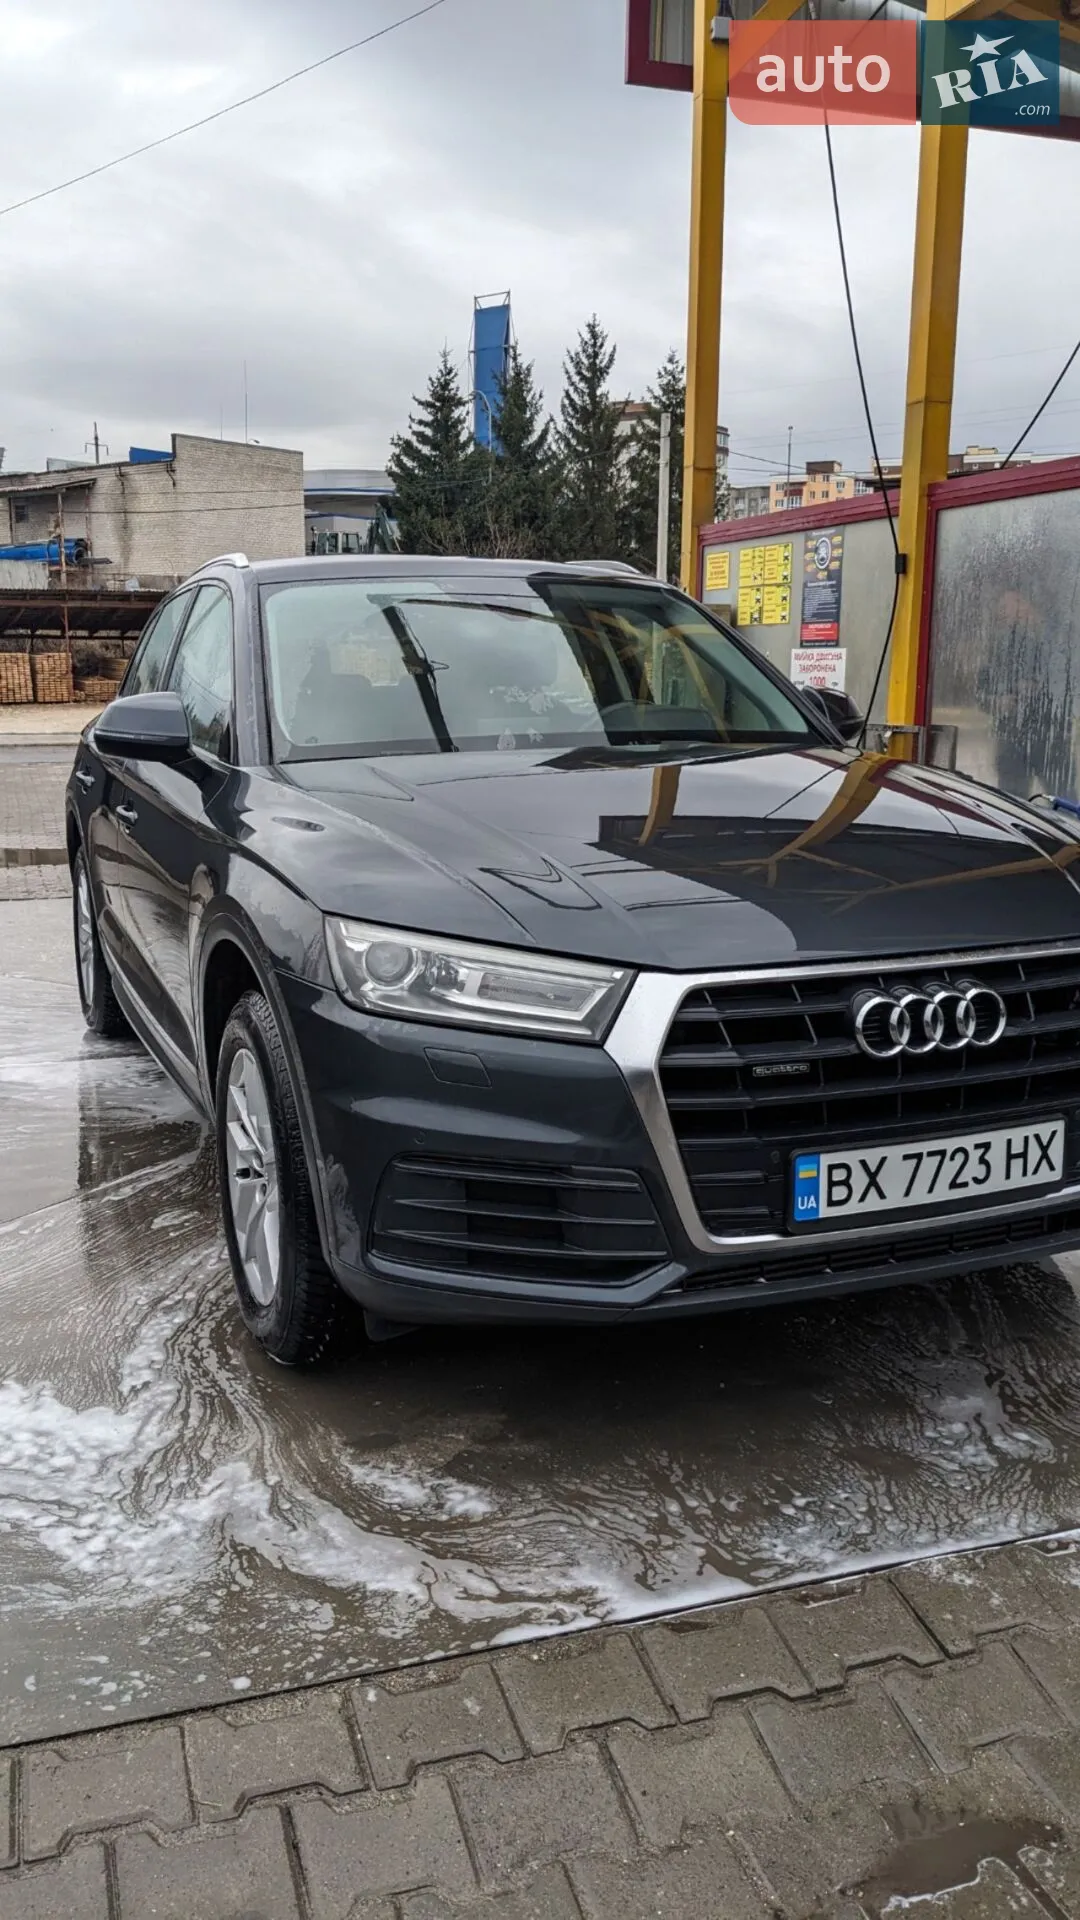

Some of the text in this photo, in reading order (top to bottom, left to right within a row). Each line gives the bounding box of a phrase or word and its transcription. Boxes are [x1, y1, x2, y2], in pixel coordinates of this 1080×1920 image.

[794, 651, 814, 661] МИЙКА
[800, 663, 836, 673] ЗАБОРОНЕНА
[755, 1065, 808, 1075] quattro
[826, 1129, 1058, 1208] BX 7723 HX
[798, 1196, 817, 1210] UA
